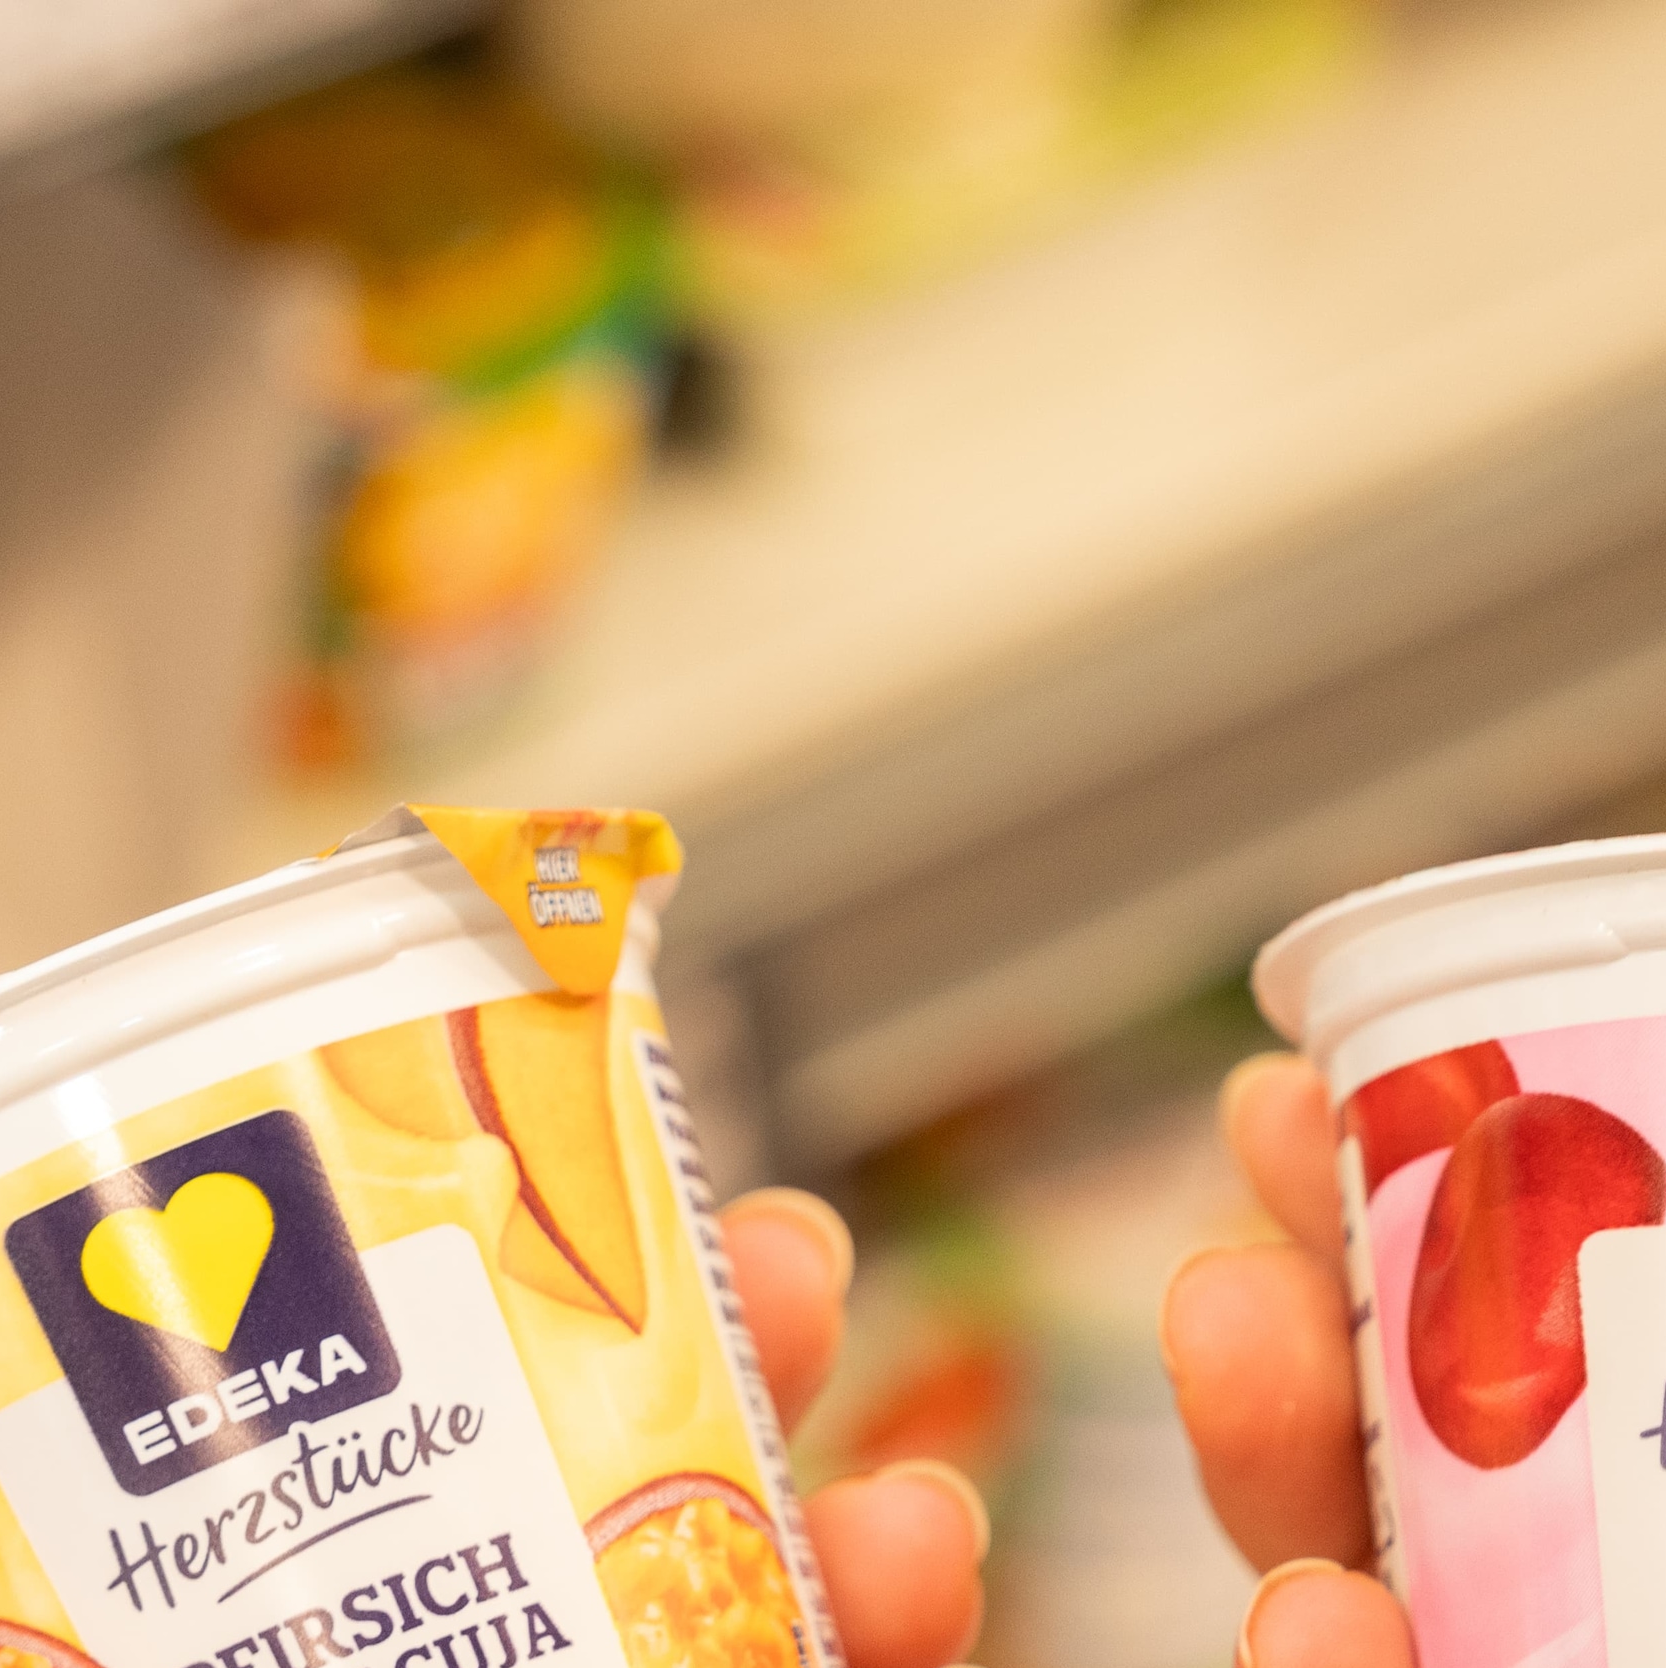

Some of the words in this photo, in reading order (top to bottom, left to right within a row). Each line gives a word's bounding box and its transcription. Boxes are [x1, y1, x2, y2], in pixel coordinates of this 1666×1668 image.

[527, 882, 603, 927] ÖFFNEN
[535, 848, 579, 883] HIER
[122, 1333, 367, 1466] EDEKA
[108, 1402, 484, 1612] Herzstücke
